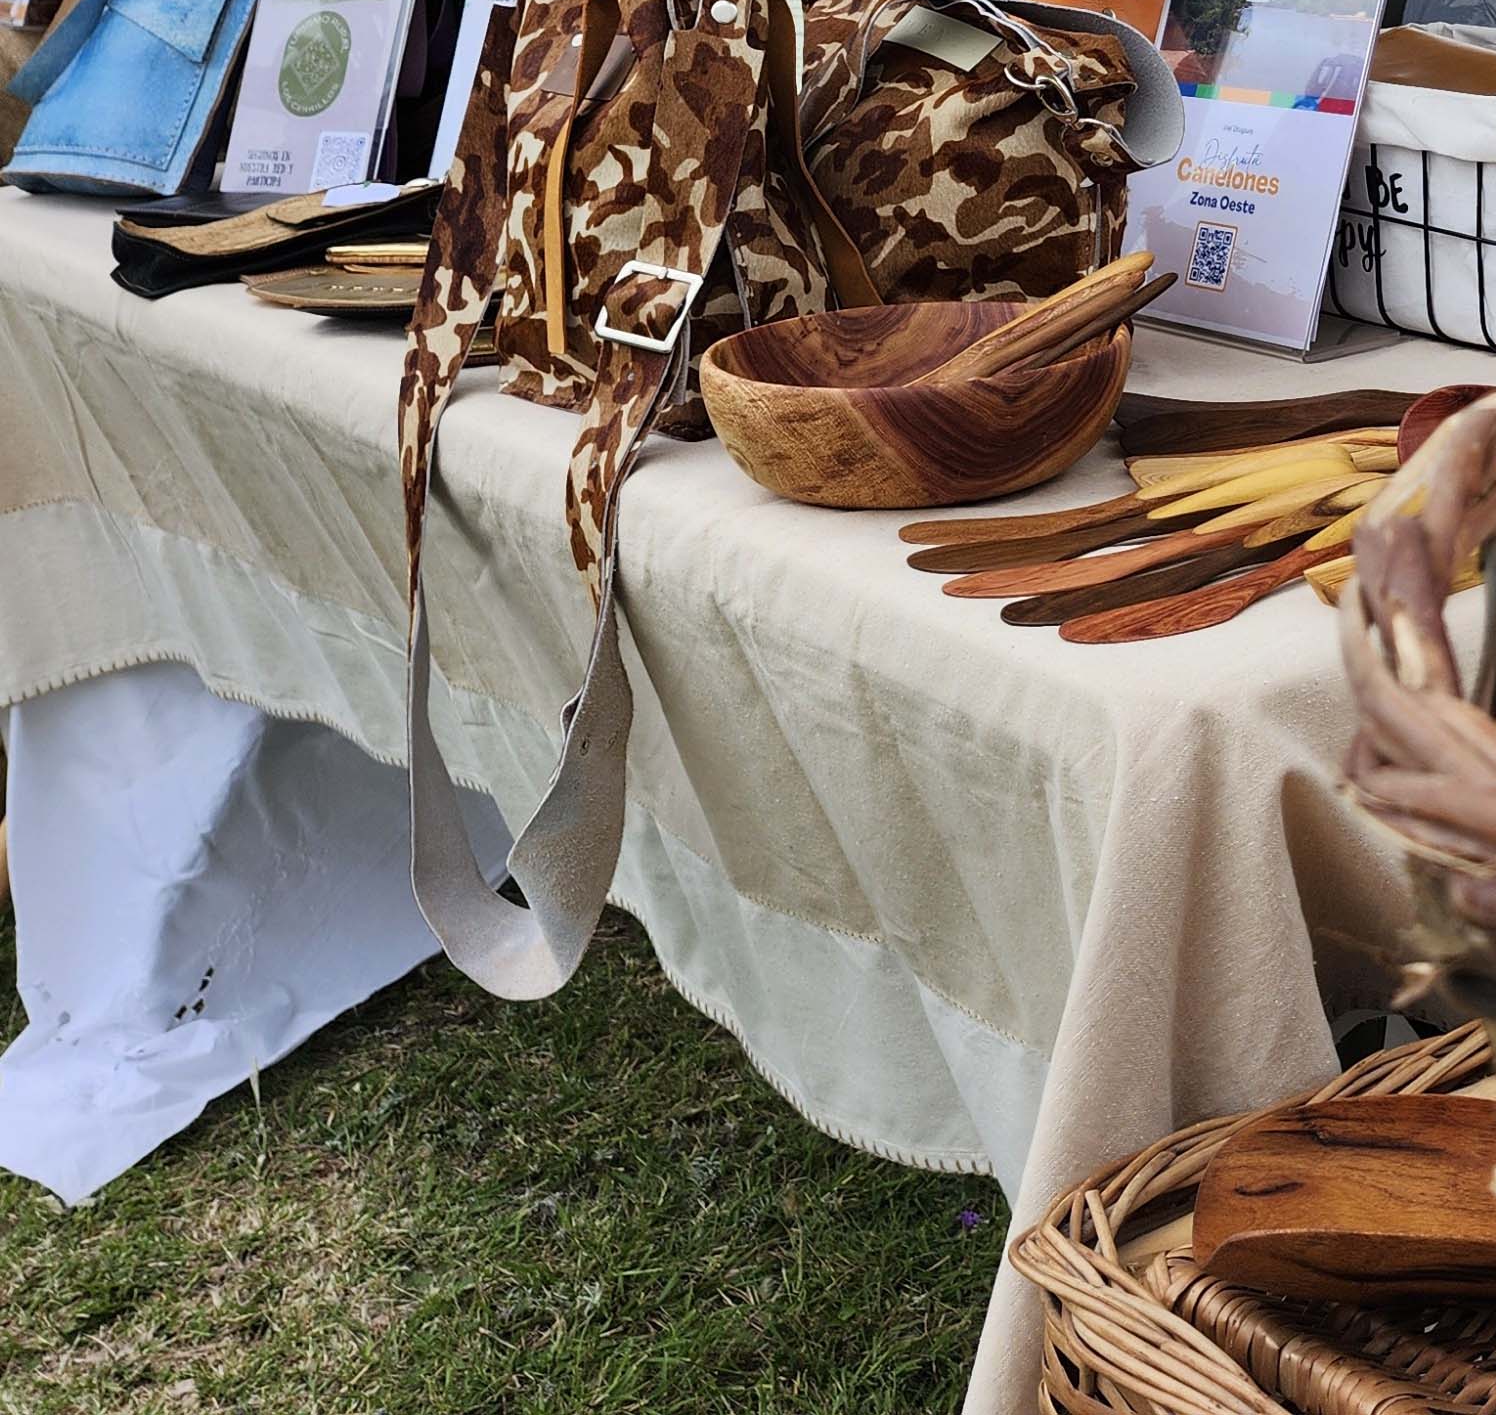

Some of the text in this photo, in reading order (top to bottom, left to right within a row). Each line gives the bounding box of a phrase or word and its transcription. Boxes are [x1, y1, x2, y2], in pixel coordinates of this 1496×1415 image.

[1177, 157, 1280, 196] Canelones
[1190, 191, 1255, 215] Zona Oeste
